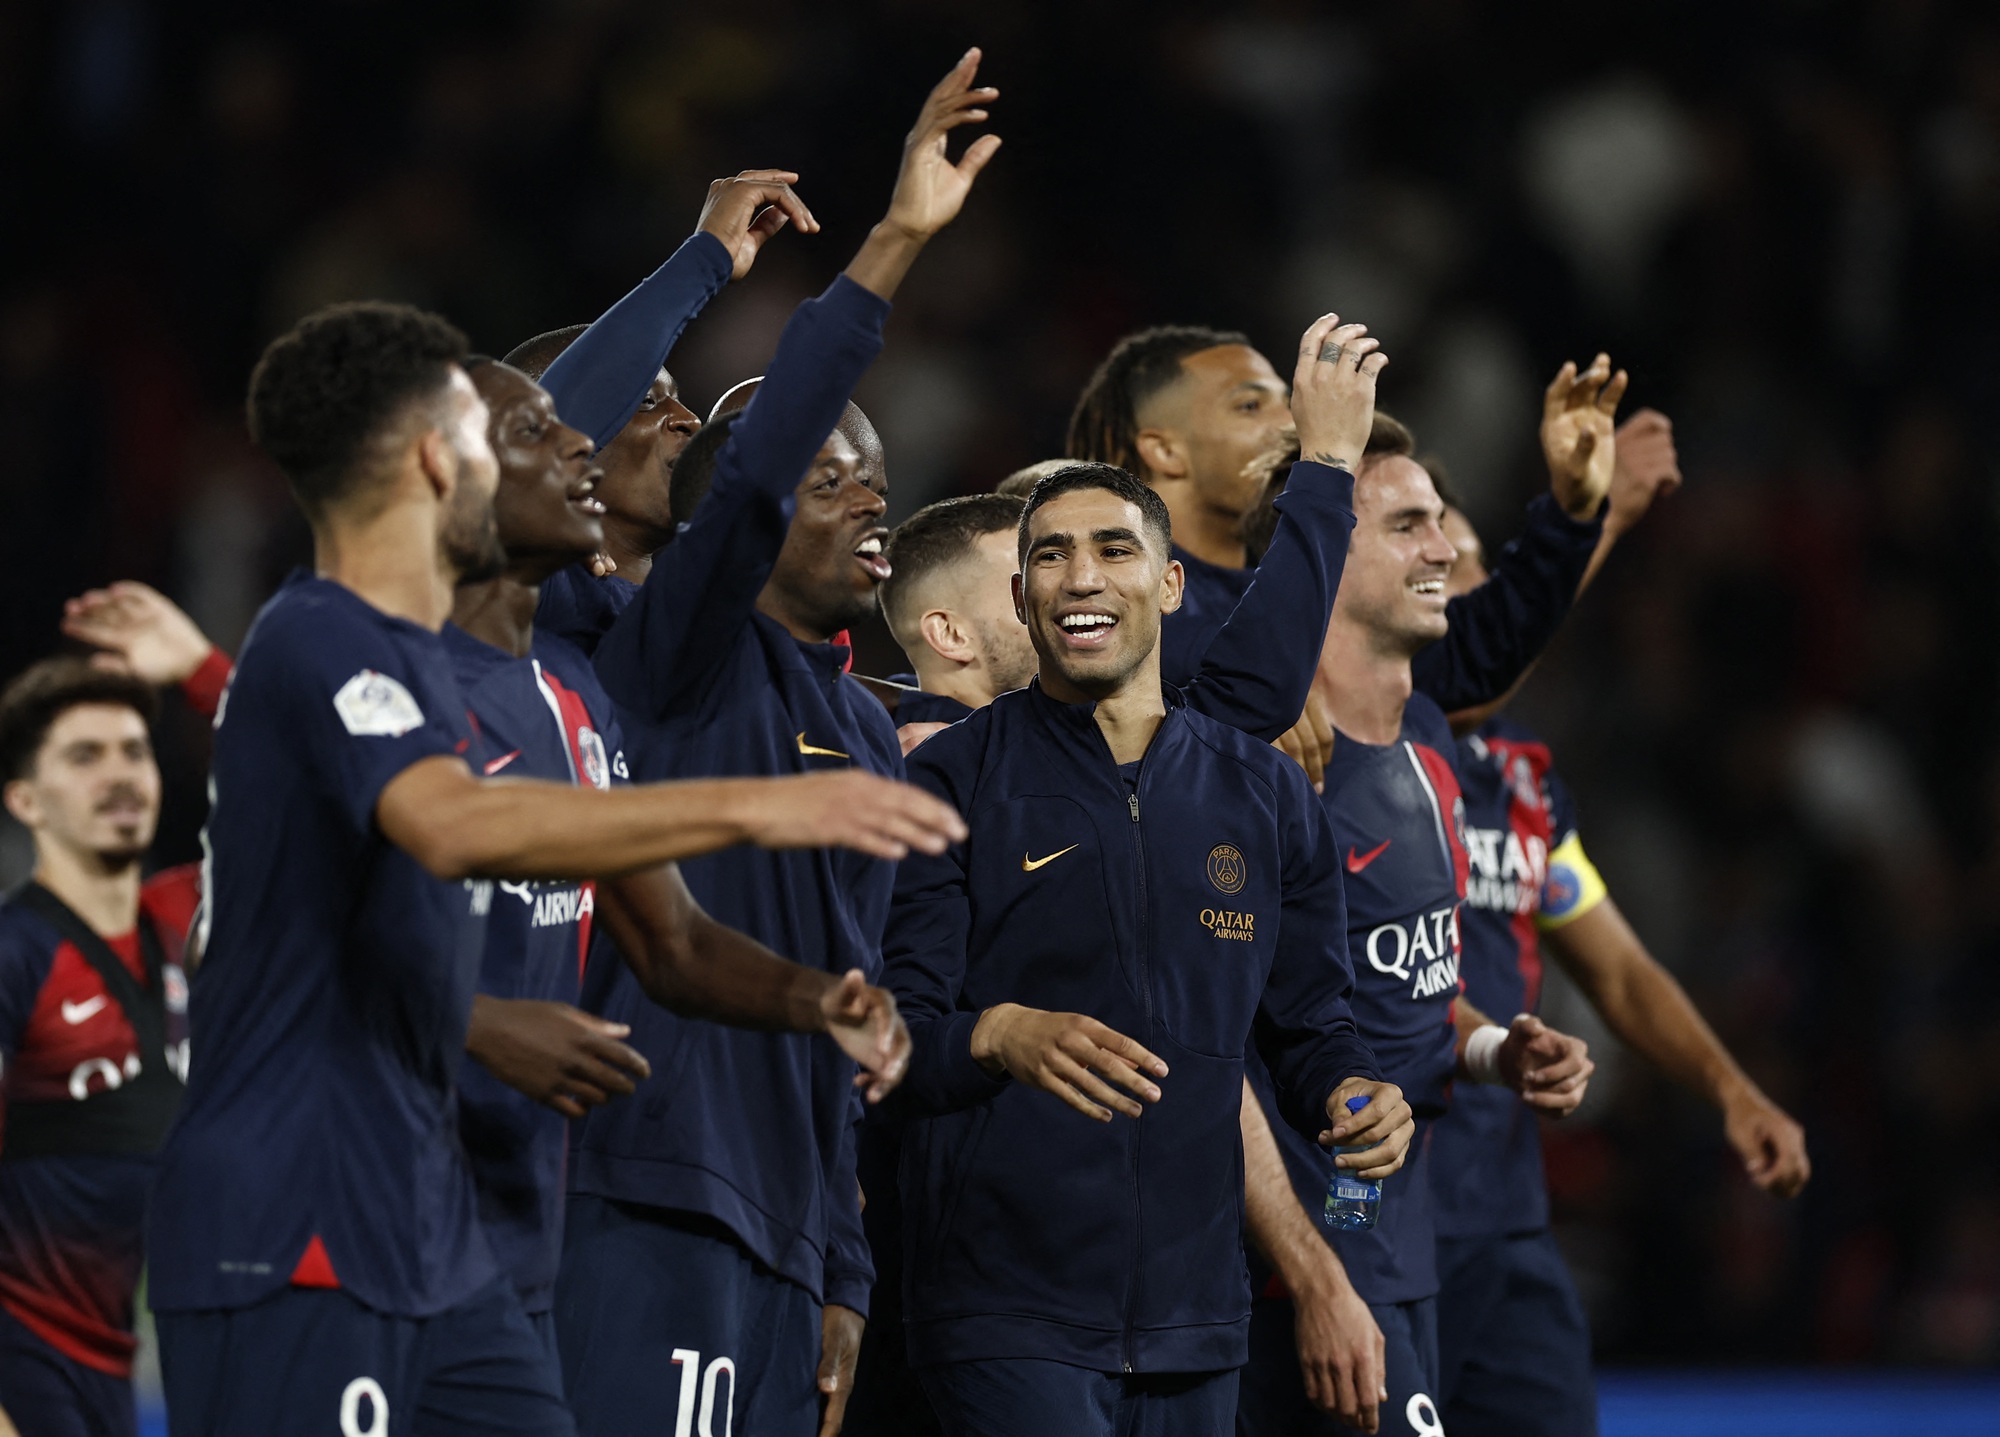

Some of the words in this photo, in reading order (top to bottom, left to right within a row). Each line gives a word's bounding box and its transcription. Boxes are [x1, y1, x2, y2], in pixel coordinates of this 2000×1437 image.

[1213, 847, 1239, 860] PARIS
[1199, 908, 1255, 931] QATAR
[1213, 928, 1254, 942] AIRWAYS
[670, 1347, 736, 1437] 10
[340, 1376, 389, 1437] 9
